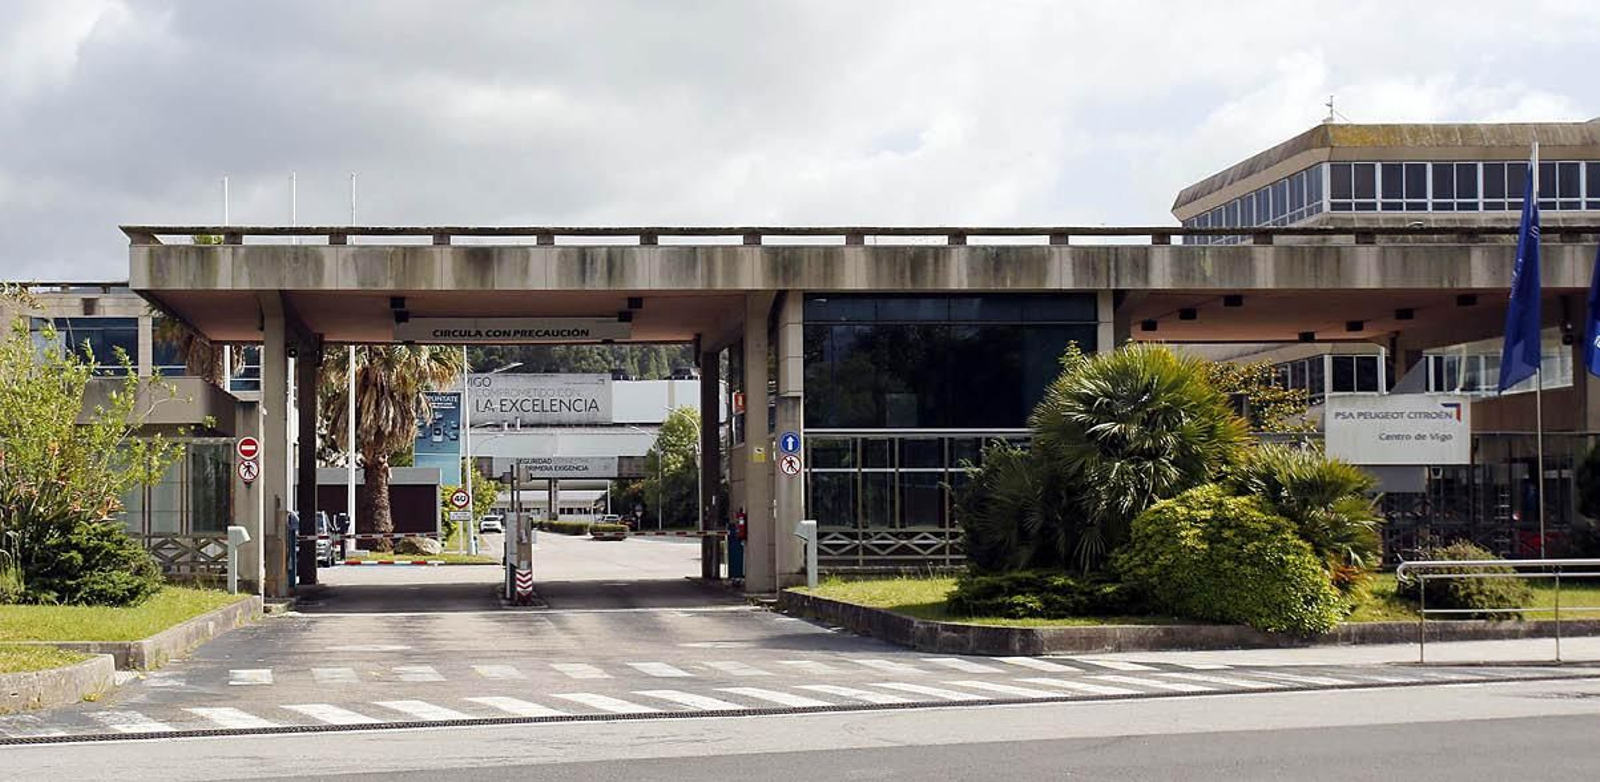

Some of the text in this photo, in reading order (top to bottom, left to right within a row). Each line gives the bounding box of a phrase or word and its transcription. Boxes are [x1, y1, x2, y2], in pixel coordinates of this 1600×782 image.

[432, 328, 589, 338] CIRCULA CON PRECAUCIÓN
[476, 398, 600, 413] LA EXCELENCIA
[1335, 410, 1453, 420] PSA PEUGEOT CITROËN
[1378, 432, 1453, 442] Centro de Vigo
